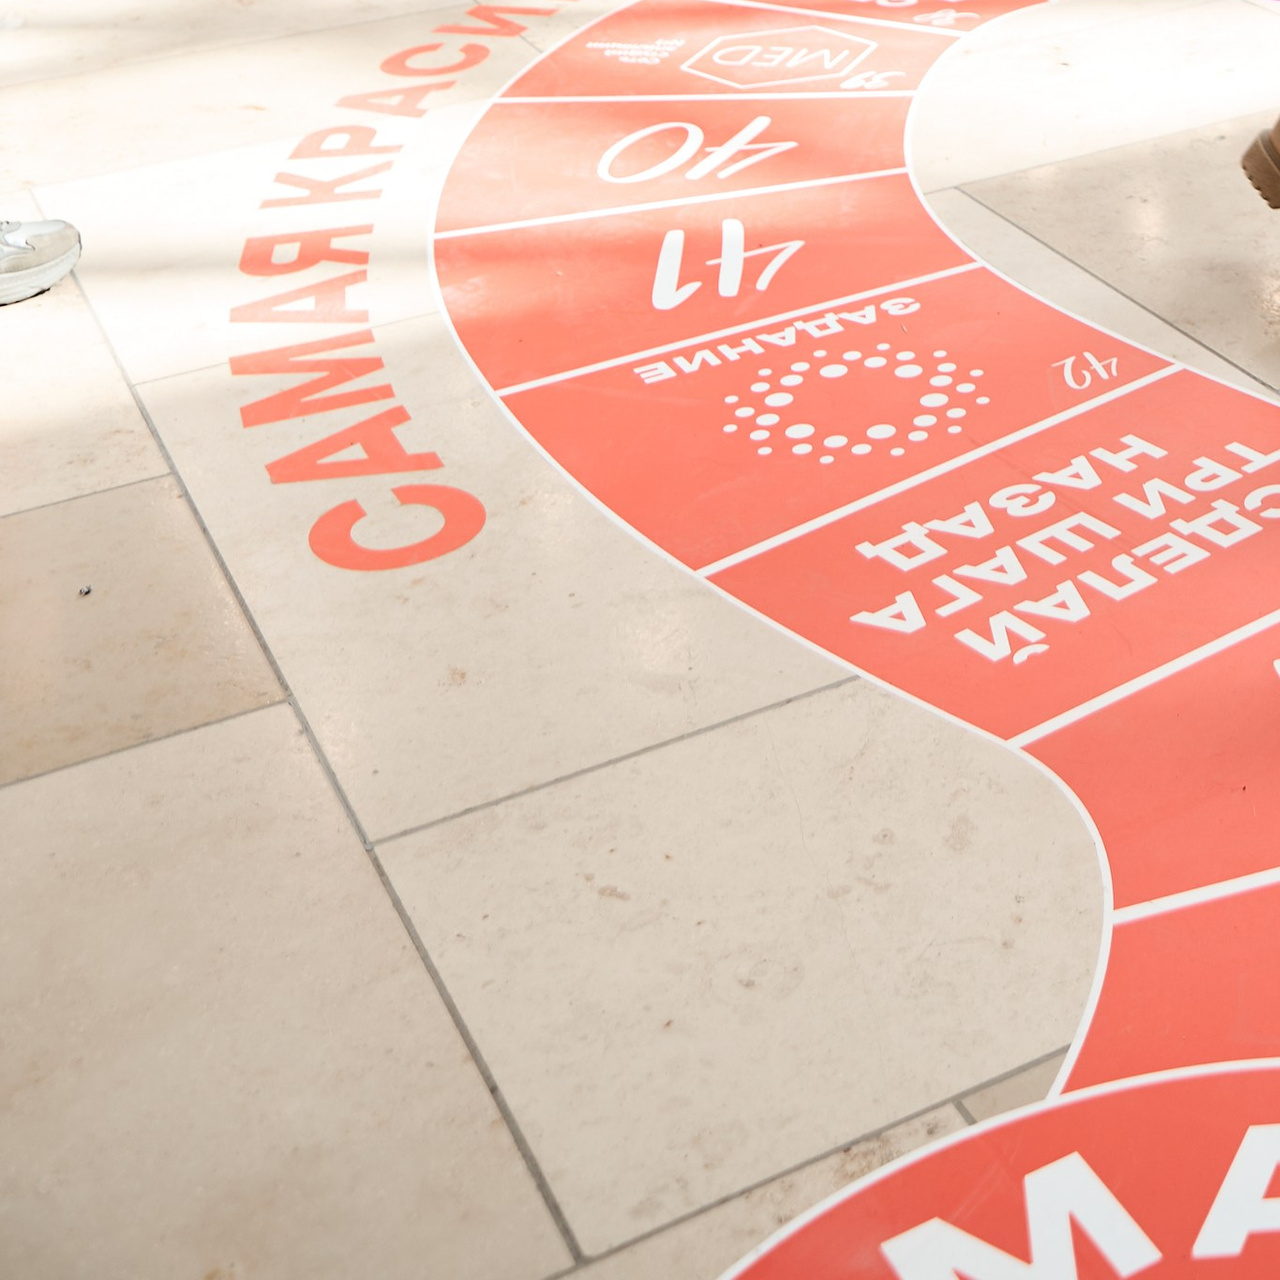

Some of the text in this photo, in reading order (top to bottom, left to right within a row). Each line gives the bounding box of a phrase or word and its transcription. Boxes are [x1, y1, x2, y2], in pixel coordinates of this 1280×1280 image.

[711, 43, 851, 71] MED
[595, 115, 800, 185] 40
[650, 218, 806, 311] 41
[632, 295, 922, 385] ЗАДАНИЕ
[1050, 351, 1119, 391] 42
[228, 223, 487, 571] САМАЯ
[855, 432, 1170, 573] НАЗАД
[849, 511, 1122, 635] ШАГА
